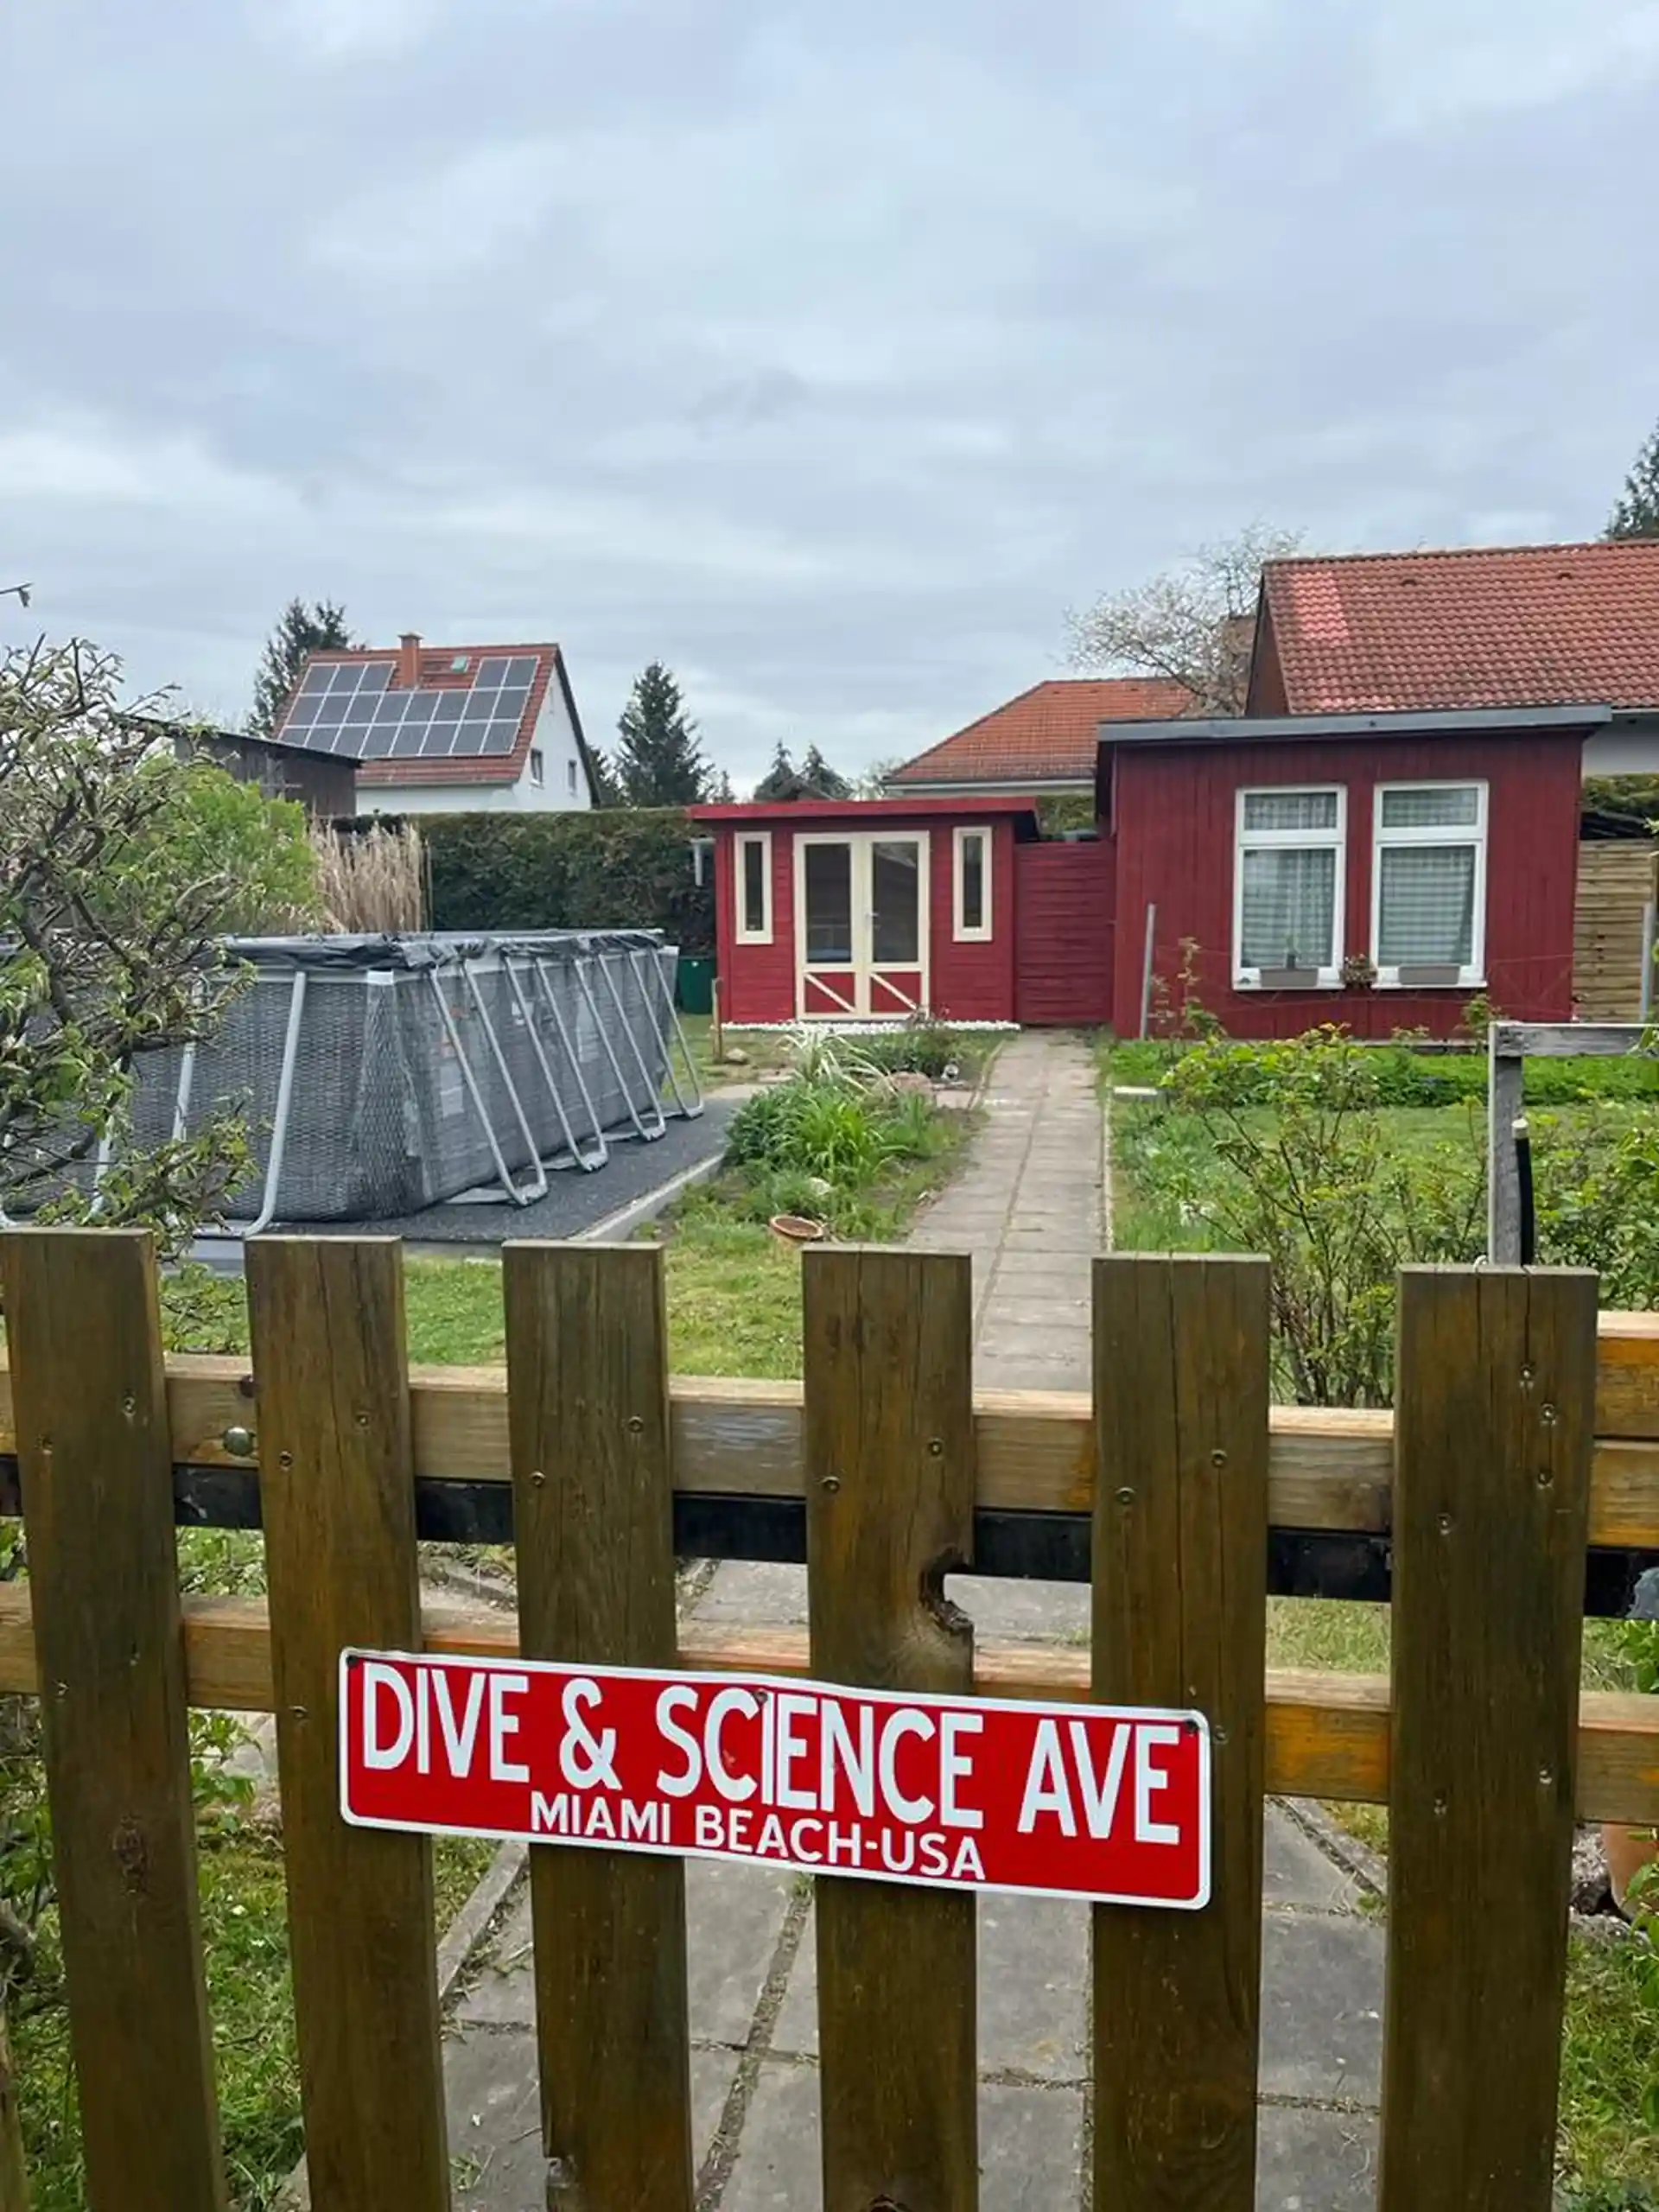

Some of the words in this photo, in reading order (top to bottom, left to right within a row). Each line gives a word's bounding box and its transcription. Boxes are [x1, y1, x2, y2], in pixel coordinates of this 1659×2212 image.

[364, 1662, 531, 1783] DIVE
[559, 1678, 623, 1790] &
[656, 1685, 983, 1829] SCIENCE
[1017, 1719, 1180, 1845] AVE
[530, 1790, 670, 1843] MIAMI
[695, 1804, 986, 1880] BEACH-USA
